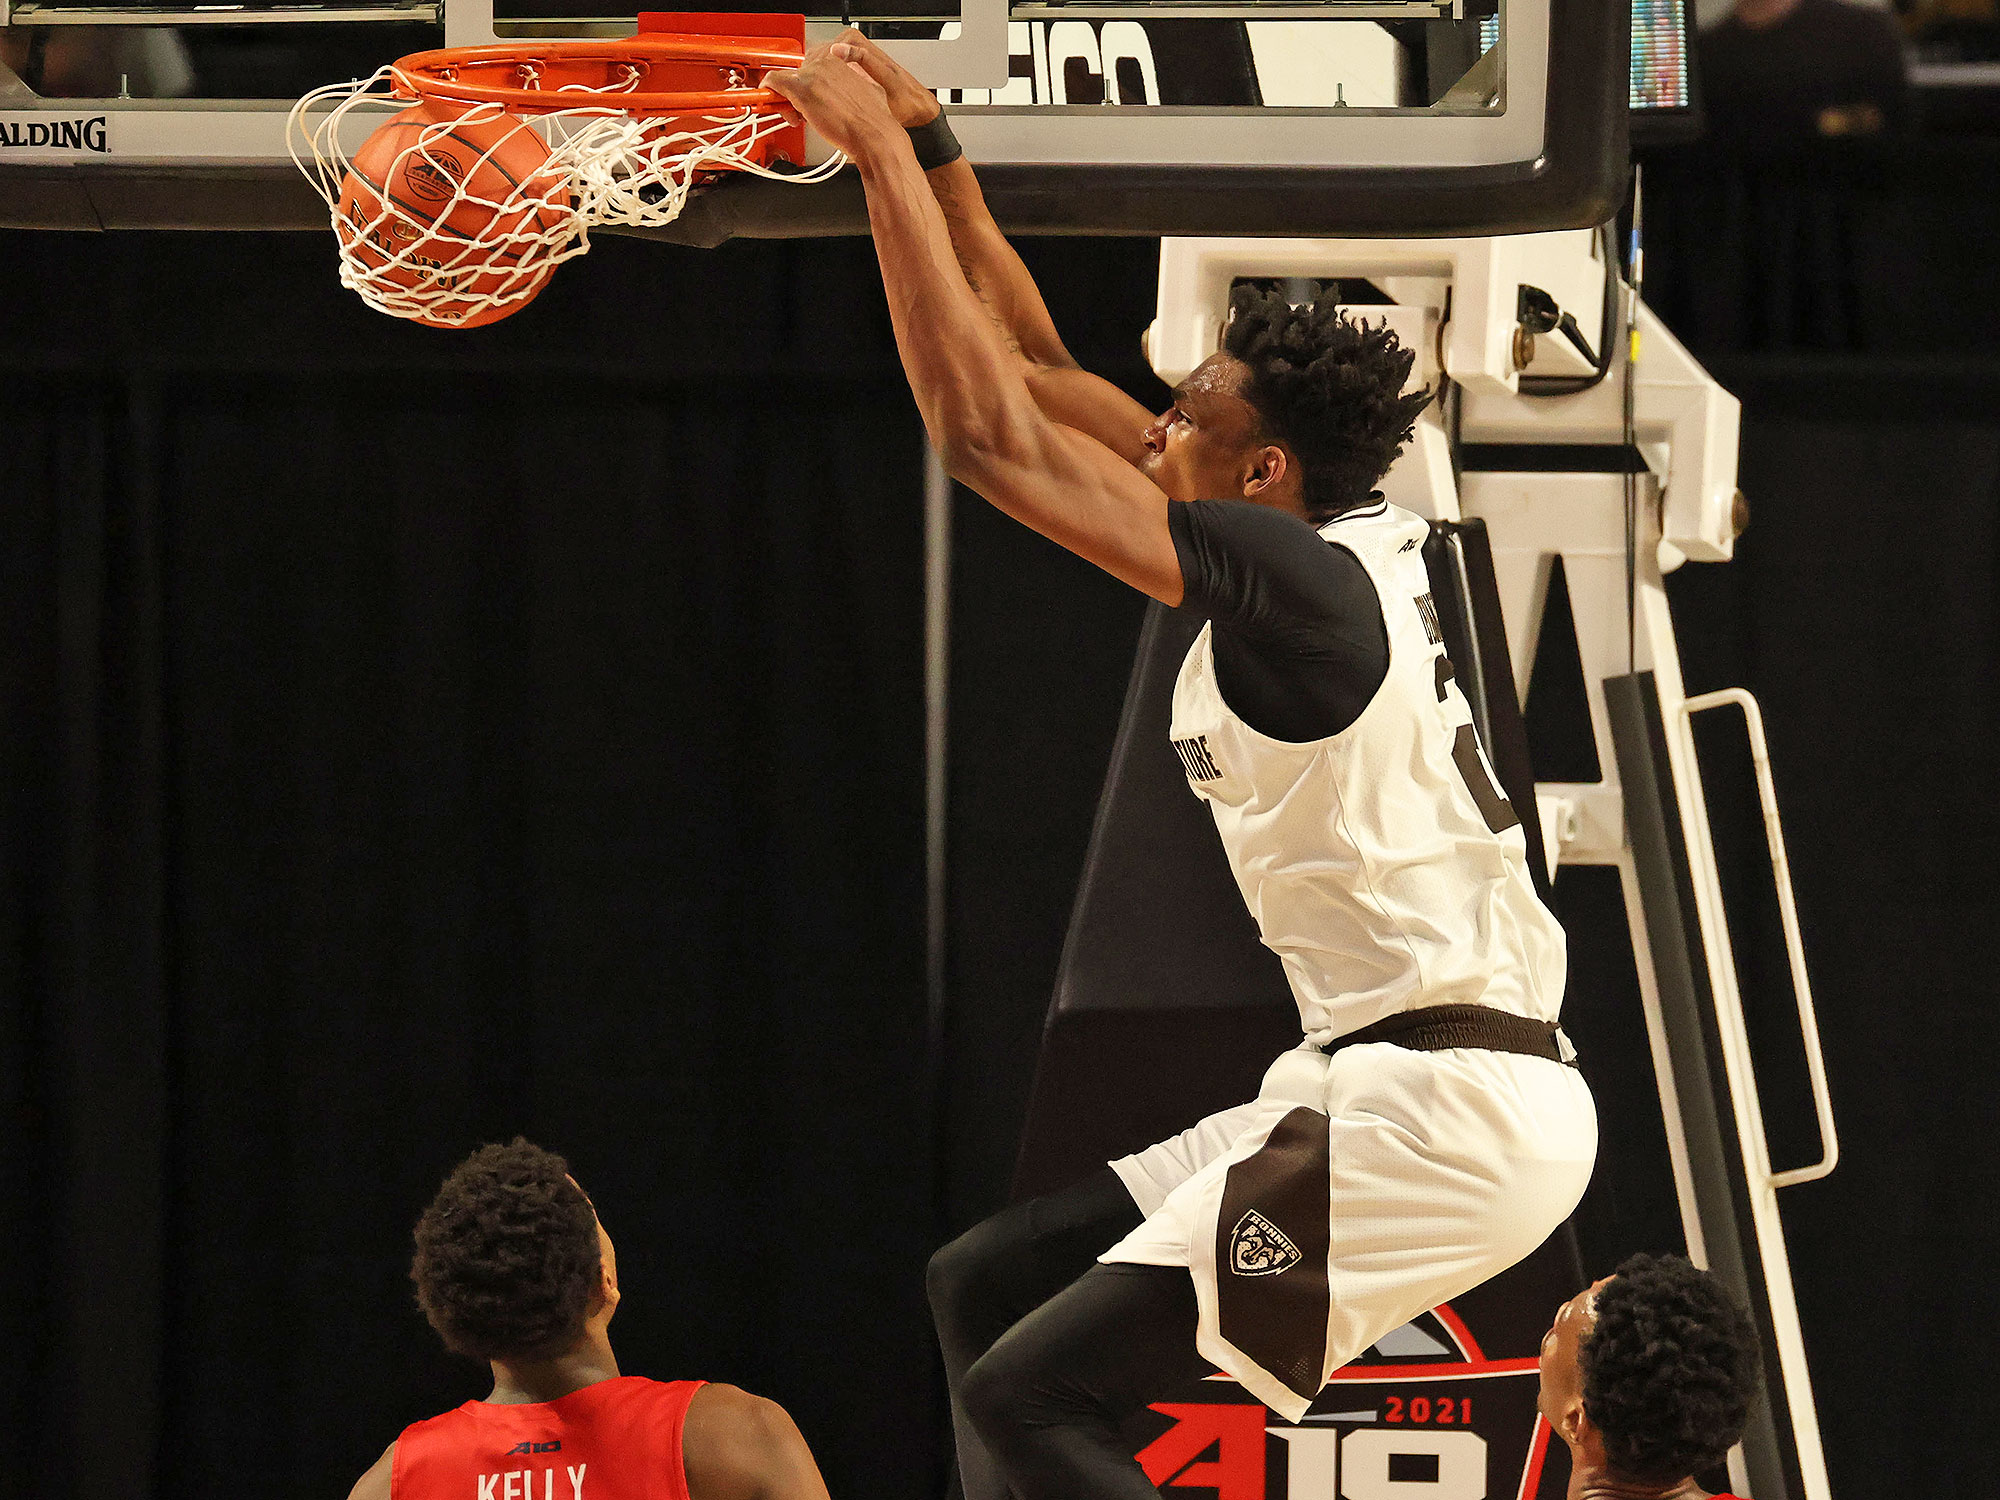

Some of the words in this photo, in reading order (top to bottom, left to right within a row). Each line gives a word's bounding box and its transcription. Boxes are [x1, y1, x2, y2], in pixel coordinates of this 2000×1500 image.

[1247, 1214, 1298, 1261] BONNIES
[1385, 1396, 1473, 1424] 2021
[504, 1440, 562, 1456] A10
[477, 1463, 587, 1500] KELLY
